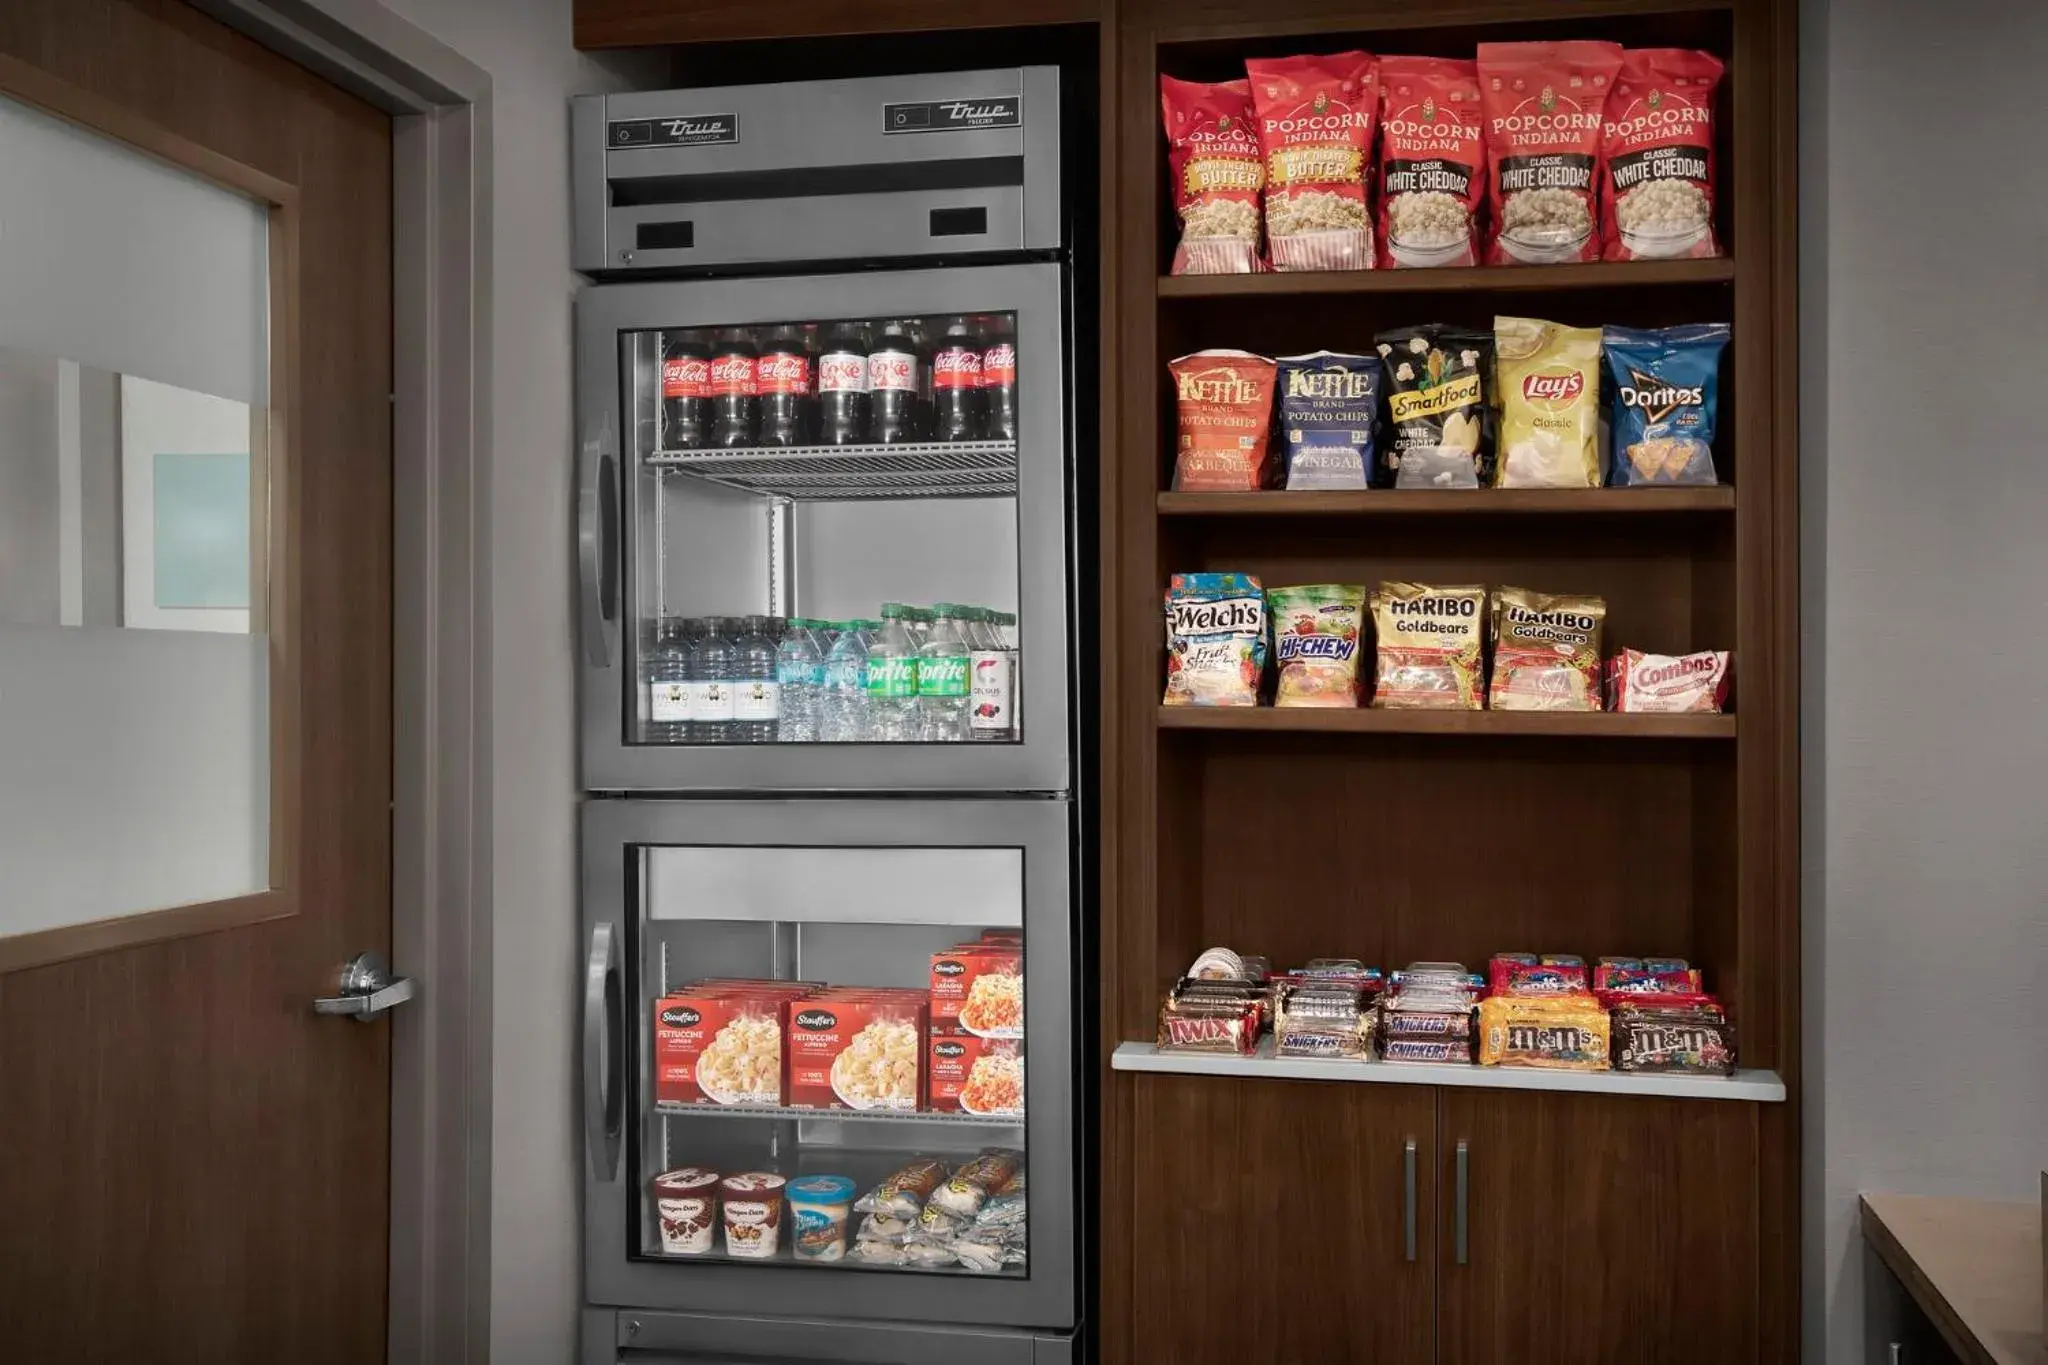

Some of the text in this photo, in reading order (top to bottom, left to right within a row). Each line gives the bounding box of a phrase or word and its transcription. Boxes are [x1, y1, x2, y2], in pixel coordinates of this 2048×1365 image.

[1265, 112, 1370, 133] POPCORN
[1381, 120, 1480, 141] POPCORN
[1492, 113, 1603, 134] POPCORN
[1604, 107, 1710, 138] POPCORN
[1284, 130, 1351, 144] INDIANA
[1512, 131, 1582, 145] INDIANA
[1625, 124, 1694, 146] INDIANA
[1194, 142, 1260, 156] INDIANA
[1395, 137, 1460, 152] INDIANA
[1530, 156, 1563, 167] CLASSIC
[1643, 148, 1678, 160] CLASSIC
[1287, 161, 1346, 177] BUTTER
[1411, 161, 1443, 171] CLASSIC
[1614, 157, 1707, 188] WHITE CHEDDAR
[1201, 170, 1257, 186] BUTTER
[1386, 170, 1468, 194] WHITE CHEDDAR
[1502, 166, 1591, 191] WHITE CHEDDAR
[1527, 372, 1580, 400] Lay's
[1395, 379, 1479, 416] Smartfood
[1620, 386, 1703, 407] Doritos
[1180, 416, 1257, 428] POTATO CHIPS
[1288, 412, 1369, 421] POTATO CHIPS
[1532, 418, 1572, 428] Classic
[1399, 427, 1429, 438] WHITE
[1395, 439, 1436, 450] CHEDDAR
[1175, 603, 1258, 629] Welch's
[1391, 598, 1476, 617] HARIBO
[1396, 619, 1469, 634] Goldbears
[1508, 605, 1595, 631] HARIBO
[1512, 625, 1588, 644] Goldbears
[1279, 637, 1356, 659] HI-CHEW
[918, 659, 966, 683] Sprite
[1638, 656, 1714, 687] Combos
[797, 1014, 836, 1026] Stouffer's
[1391, 1016, 1447, 1032] SNICKERS
[1284, 1034, 1340, 1047] SNICKERS
[1388, 1042, 1448, 1059] SNICKERS
